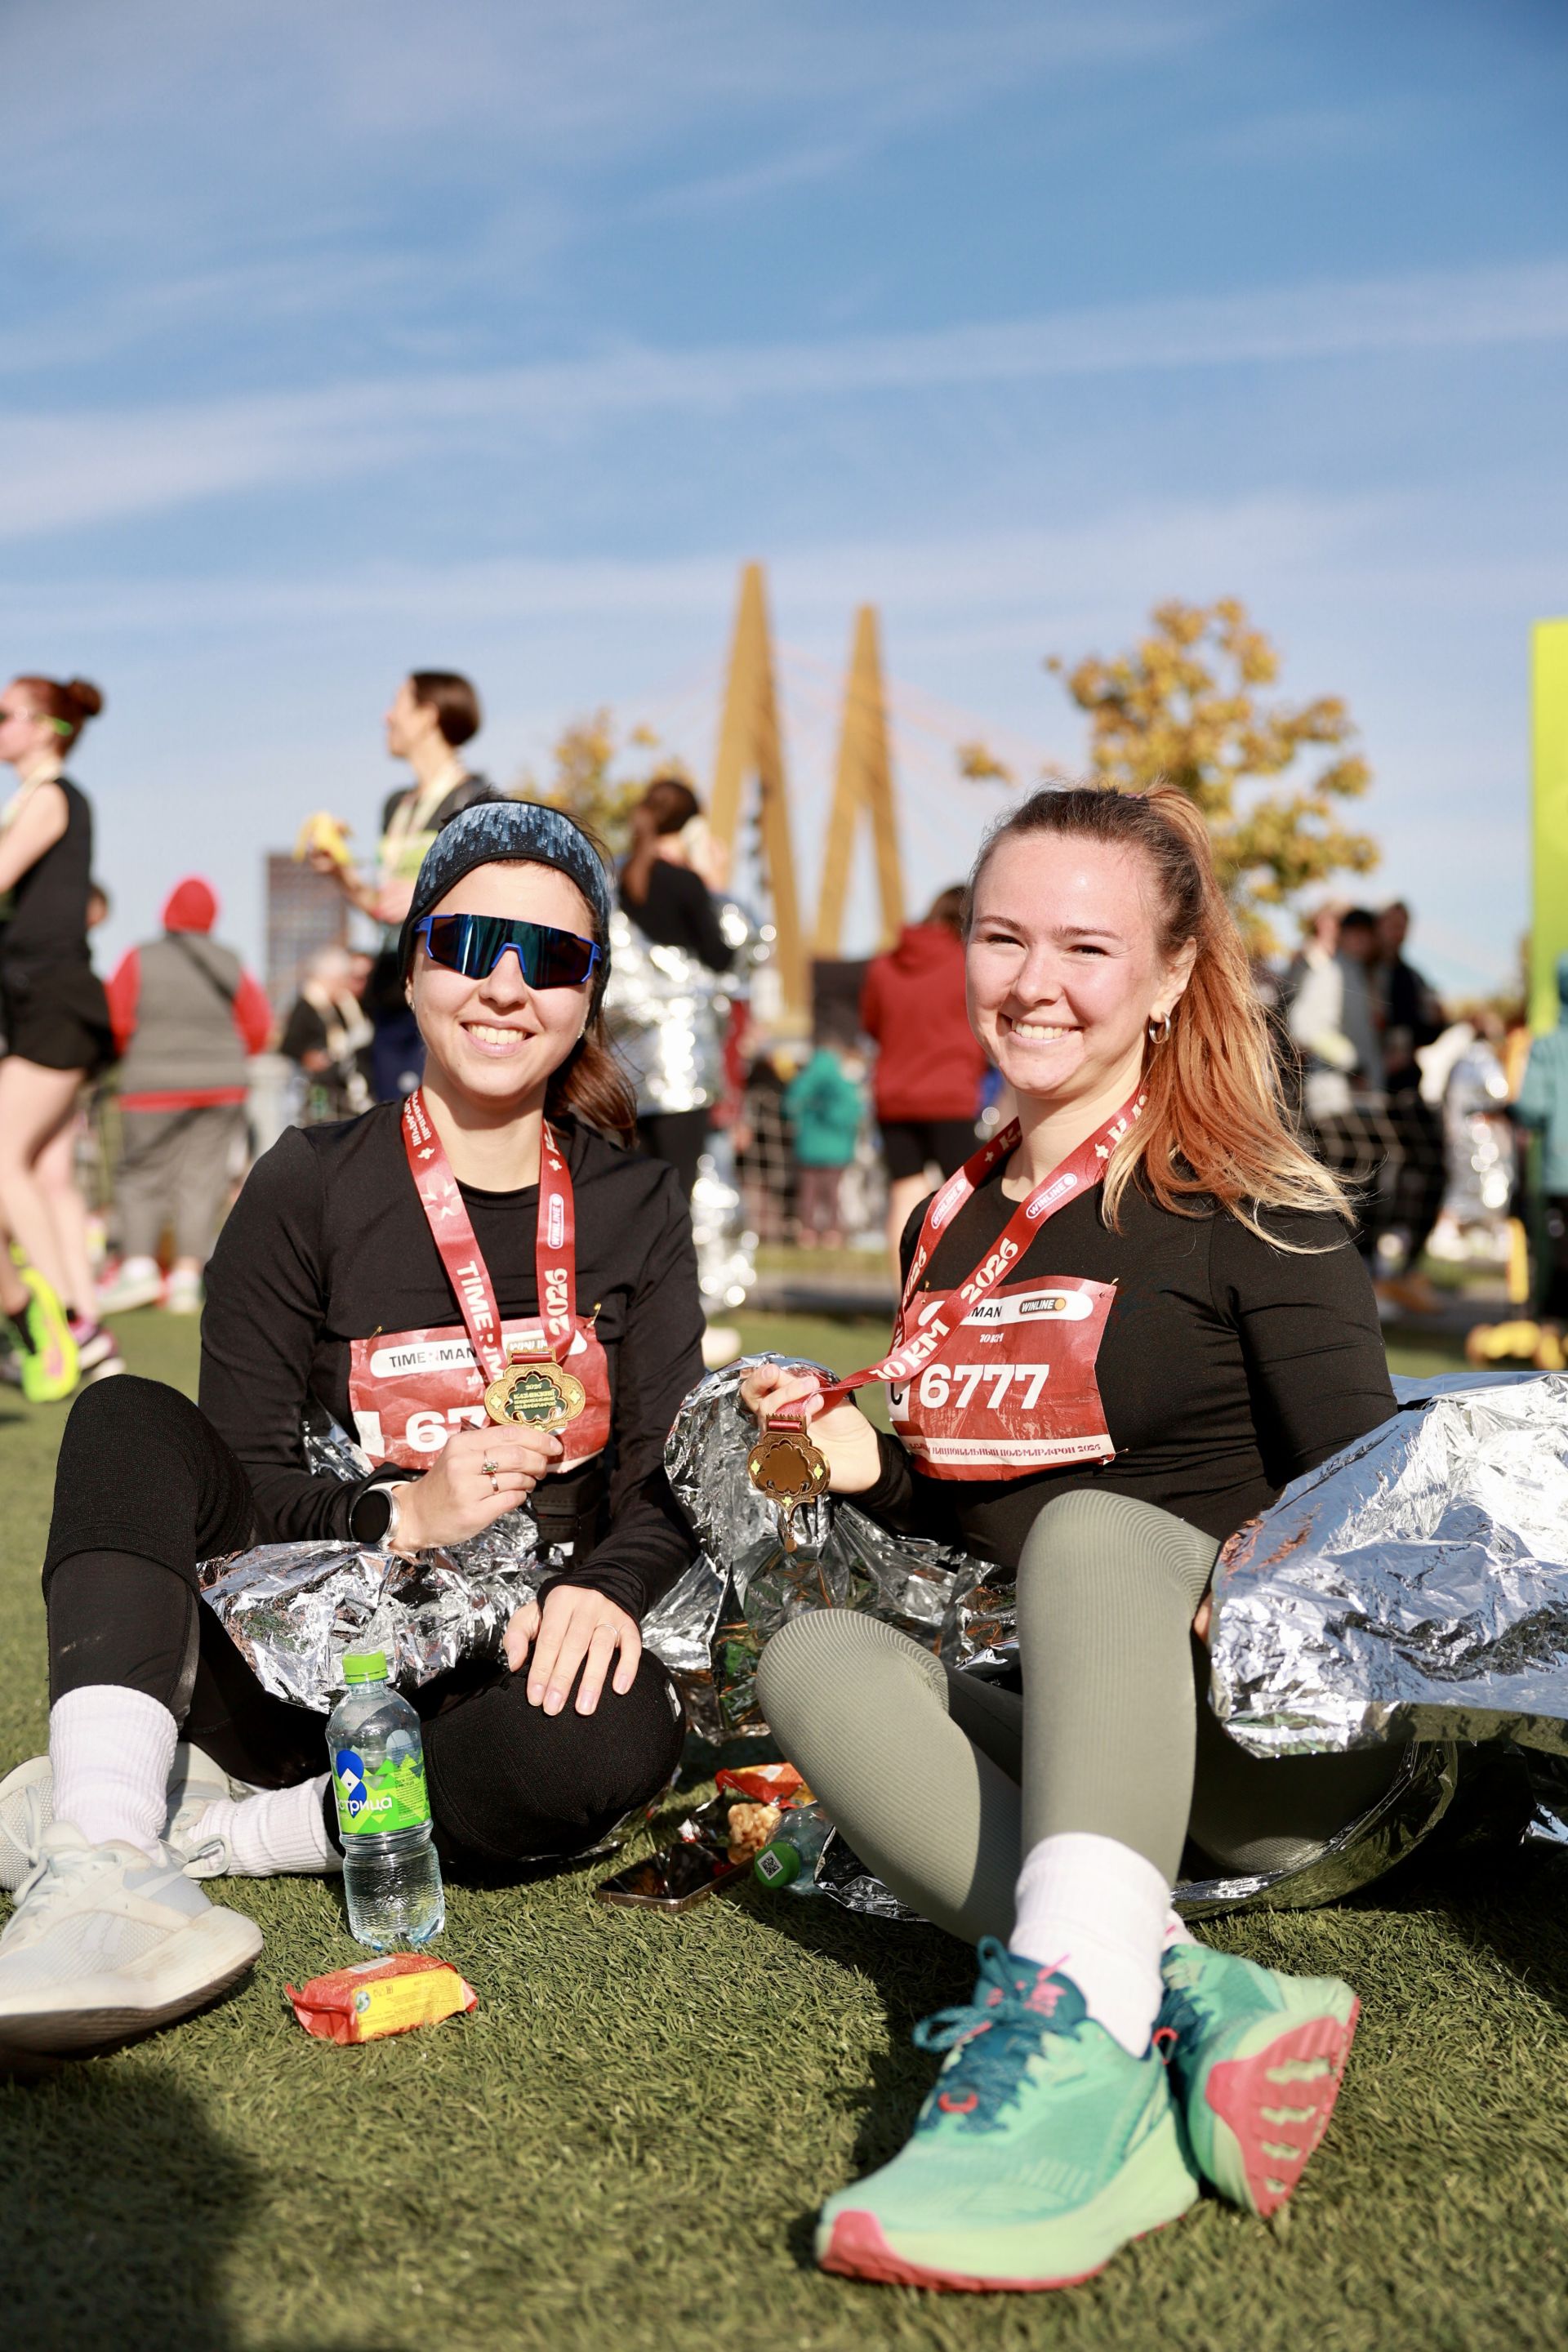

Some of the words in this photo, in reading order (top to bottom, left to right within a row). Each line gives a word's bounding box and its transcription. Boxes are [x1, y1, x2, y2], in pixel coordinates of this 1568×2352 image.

[1030, 1183, 1065, 1215] WINLINE
[550, 1205, 561, 1246] WINLINE
[544, 1267, 570, 1336] 2026
[868, 1361, 906, 1380] 10
[960, 1237, 1018, 1304] 2026
[969, 1306, 1003, 1318] MAN
[1021, 1299, 1055, 1312] WINLINE
[919, 1363, 1050, 1410] 6777
[405, 1405, 488, 1453] 67
[932, 1447, 999, 1457] НАЦИОНАЛЬНЫЙ
[1000, 1446, 1076, 1458] ПОЛУМАРАФОН
